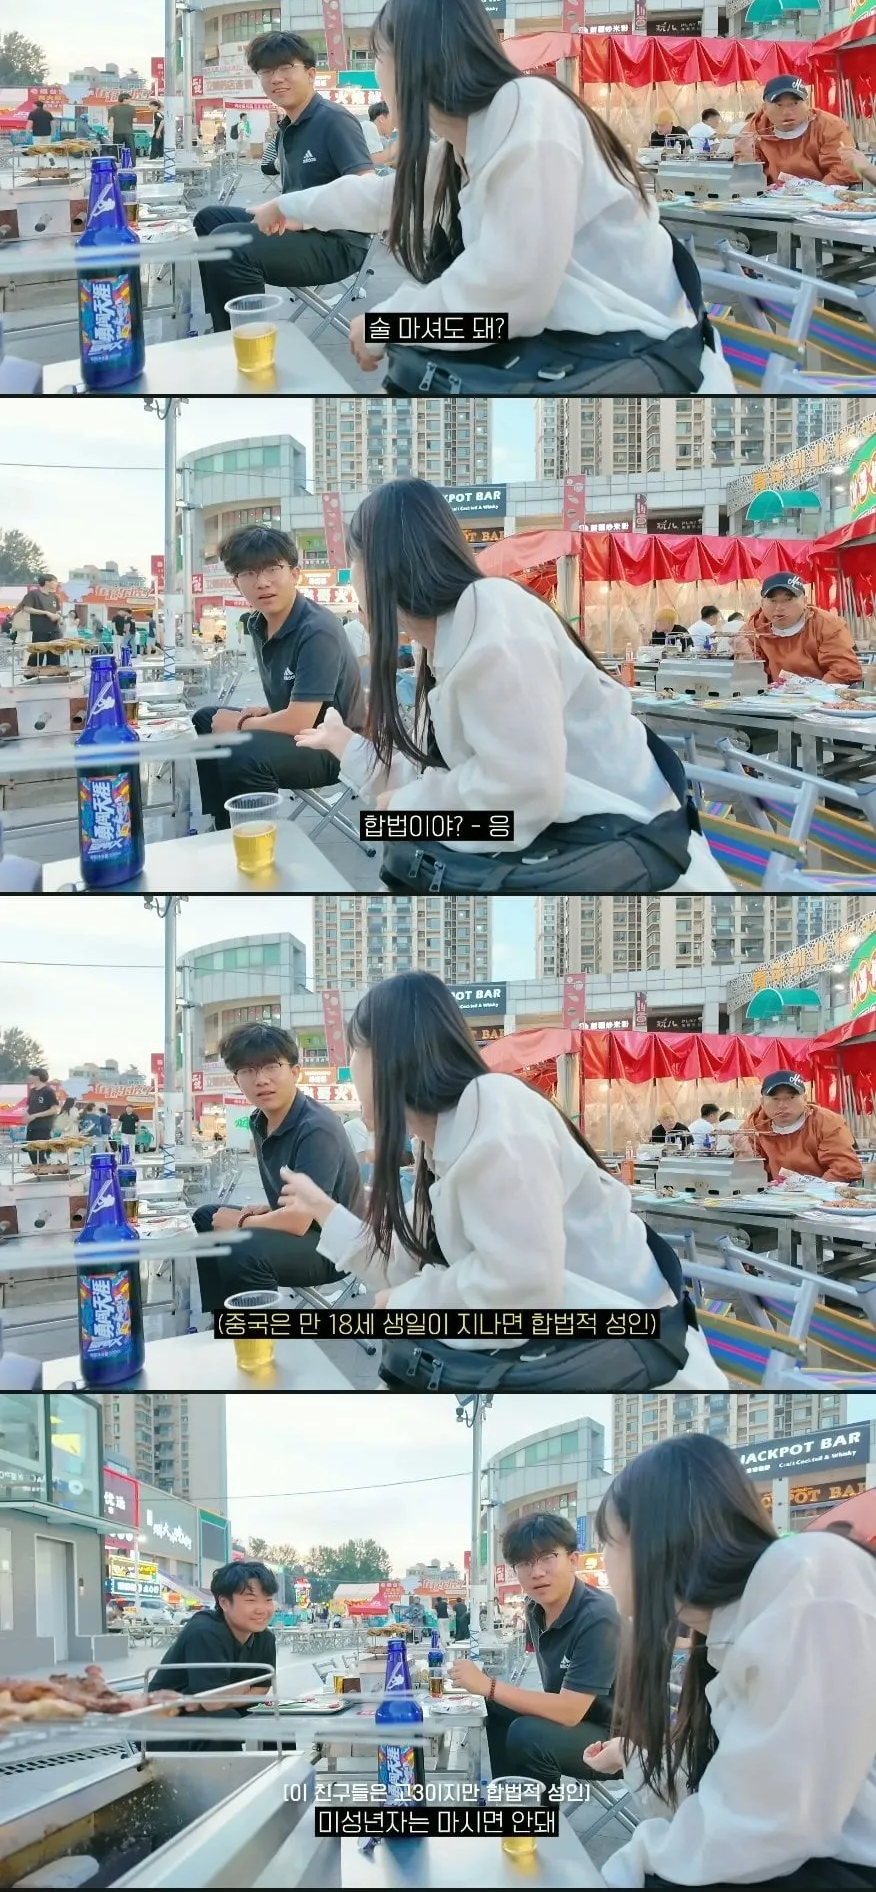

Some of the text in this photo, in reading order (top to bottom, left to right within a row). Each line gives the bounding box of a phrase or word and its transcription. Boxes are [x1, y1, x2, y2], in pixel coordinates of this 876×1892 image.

[476, 491, 502, 501] BAR
[476, 989, 502, 999] BAR
[821, 1432, 861, 1450] BAR
